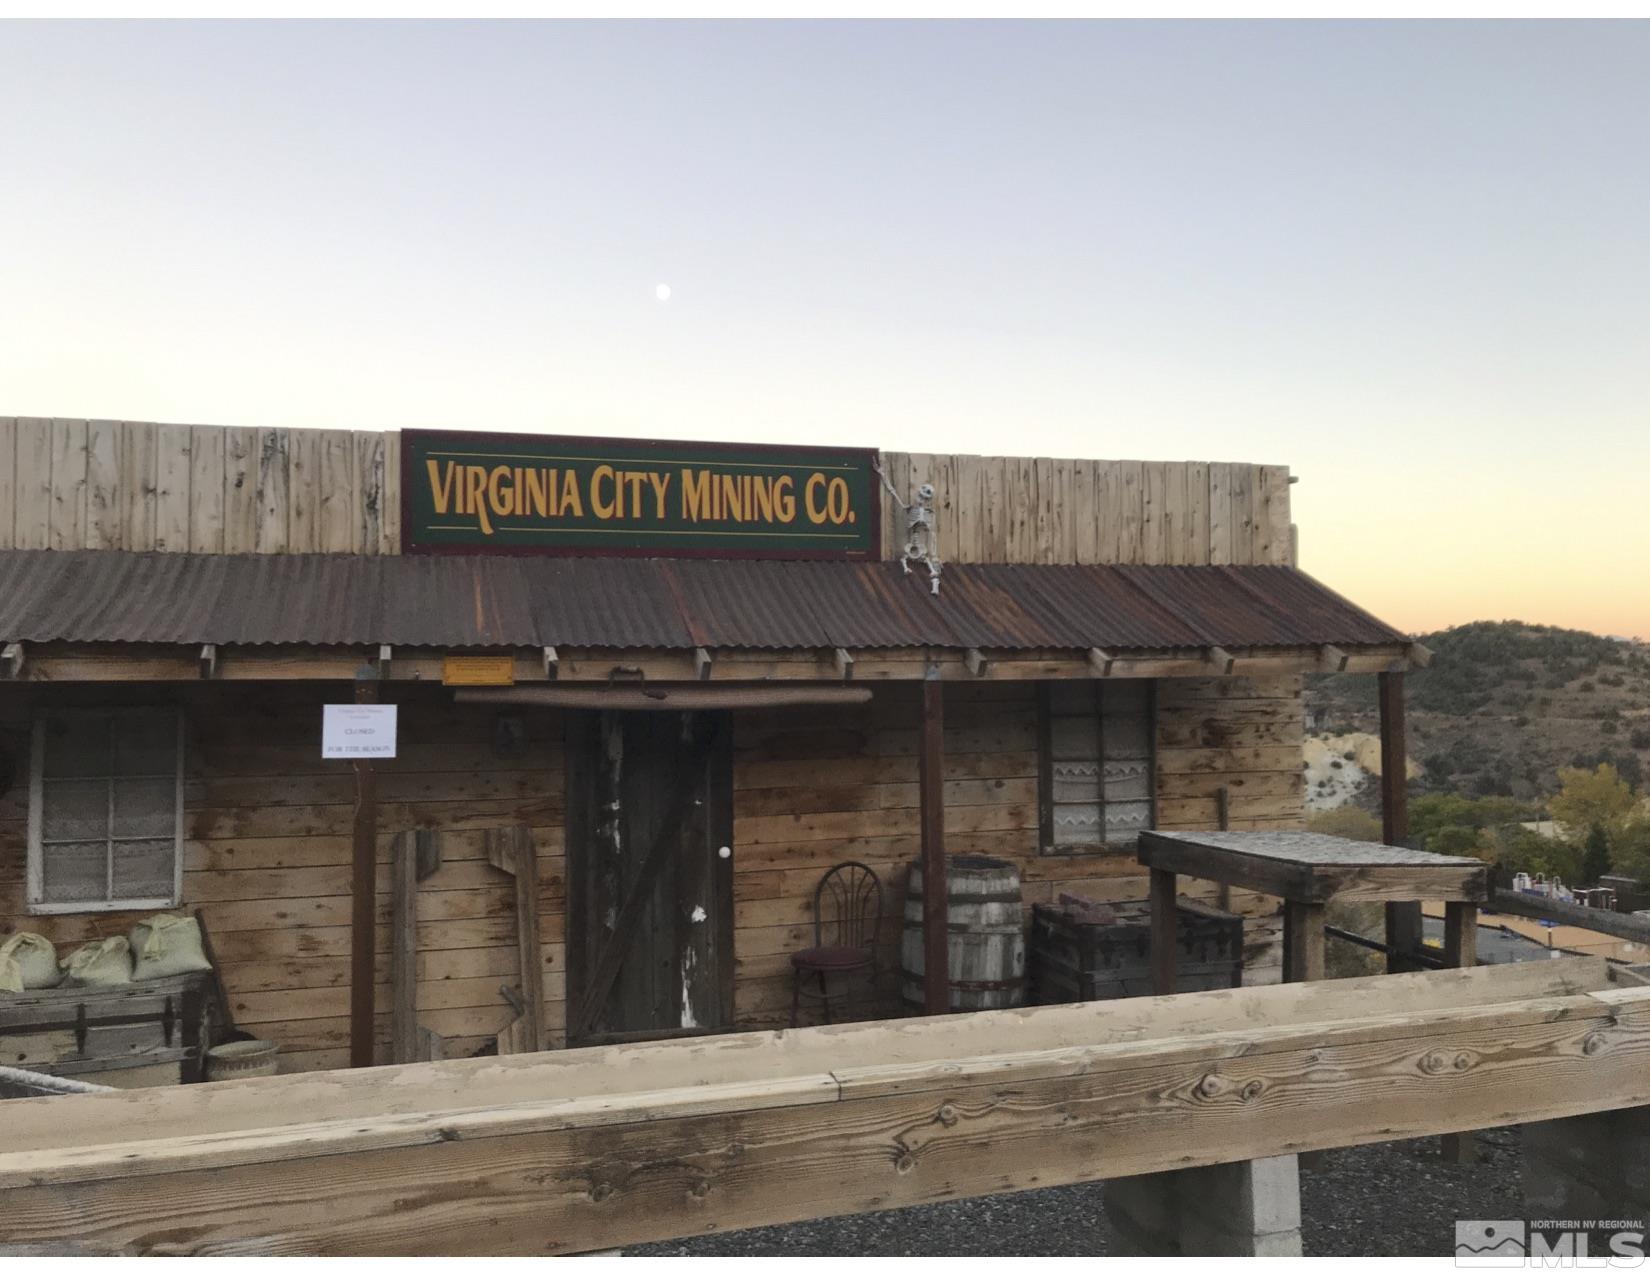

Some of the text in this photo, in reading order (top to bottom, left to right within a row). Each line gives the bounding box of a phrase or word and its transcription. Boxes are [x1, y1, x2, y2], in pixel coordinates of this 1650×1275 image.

[426, 459, 856, 535] VIRGINIA CITY MINING CO.
